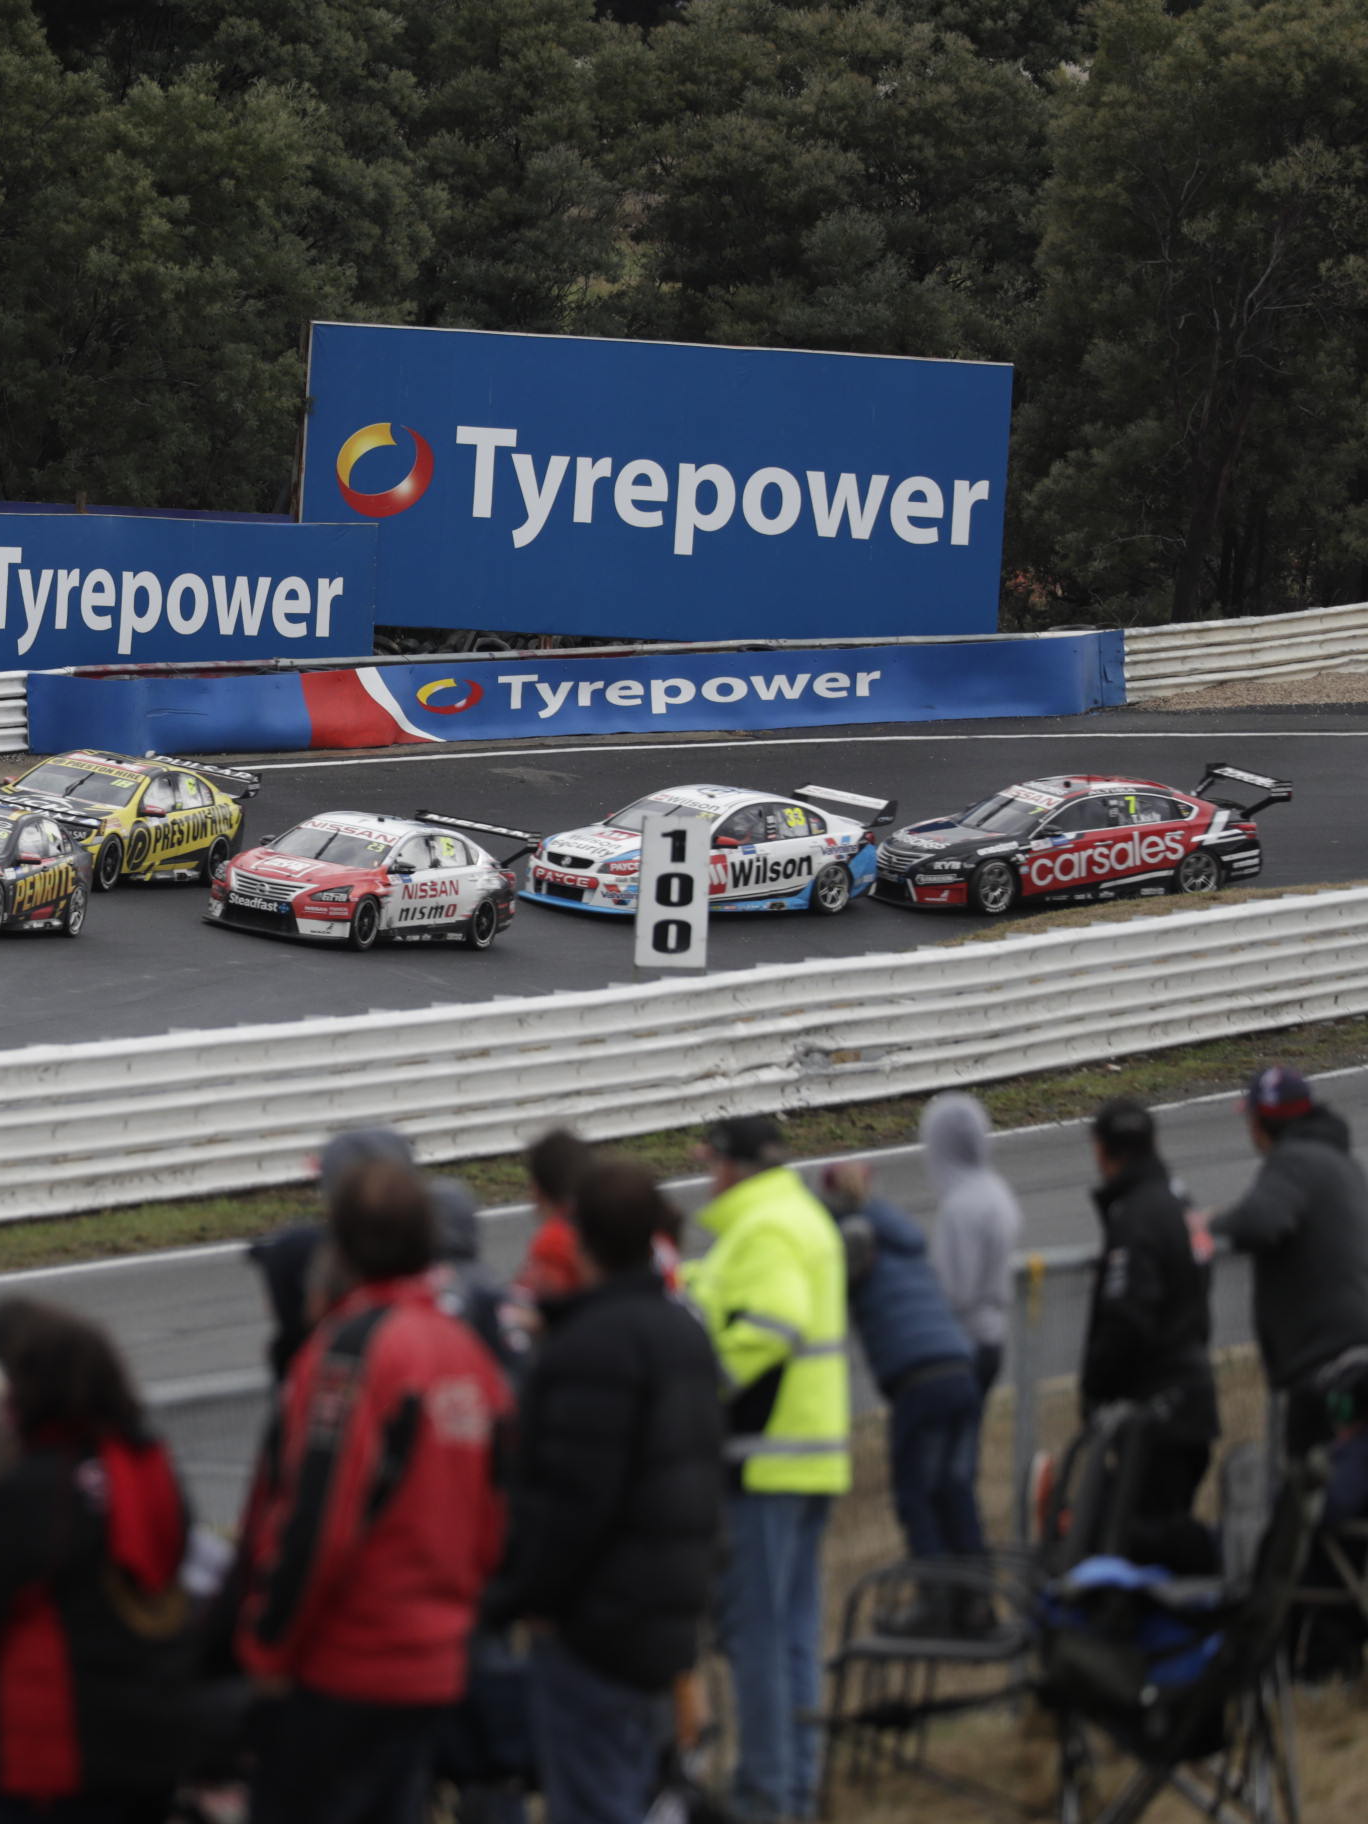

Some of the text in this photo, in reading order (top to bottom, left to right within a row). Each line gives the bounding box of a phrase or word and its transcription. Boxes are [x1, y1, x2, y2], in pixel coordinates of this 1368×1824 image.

[455, 425, 990, 556] Tyrepower
[498, 669, 881, 719] Tyrepower
[152, 809, 208, 854] PRESTON
[304, 819, 398, 844] NISSAN
[783, 807, 806, 828] 33
[366, 842, 386, 852] 23
[1031, 831, 1185, 887] carsales
[535, 867, 589, 888] PAYCE
[730, 855, 813, 889] Wilson
[13, 863, 77, 915] PENRITE
[228, 892, 279, 913] Steadfast
[401, 880, 460, 900] NISSAN
